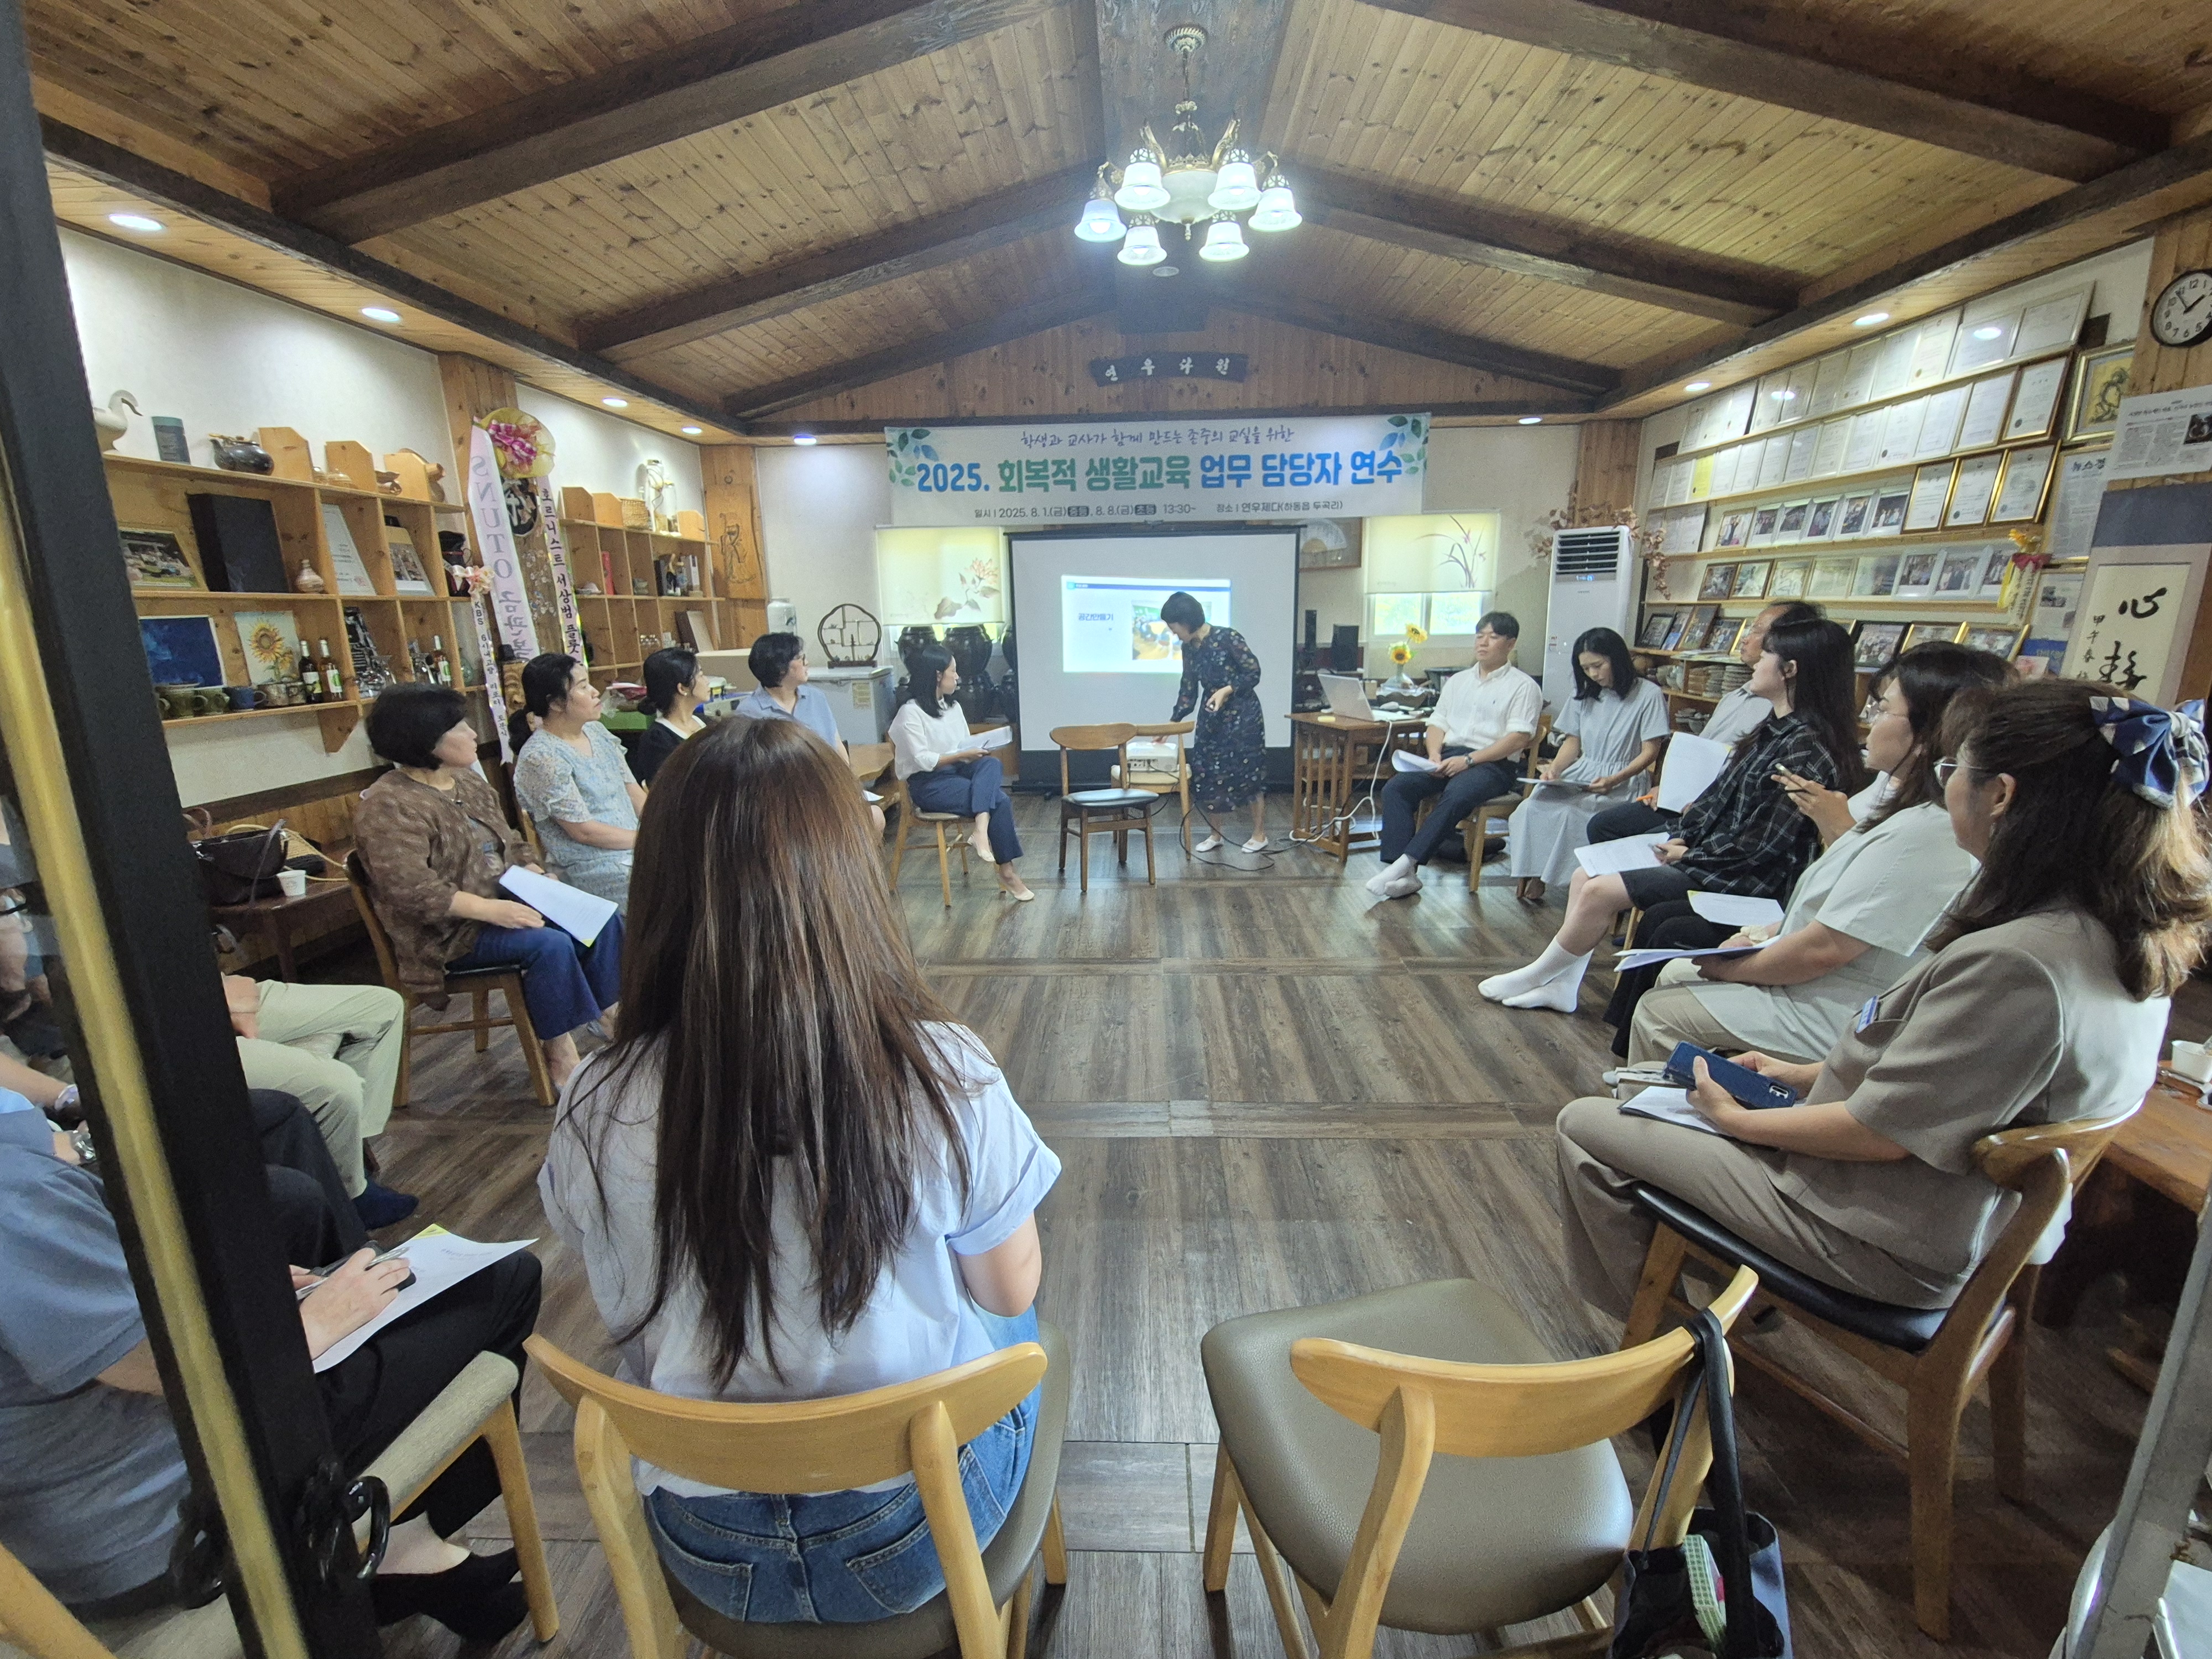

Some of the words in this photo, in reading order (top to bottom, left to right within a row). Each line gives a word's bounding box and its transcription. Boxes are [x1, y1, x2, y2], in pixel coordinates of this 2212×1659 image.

[1021, 431, 1063, 448] 학생과
[1068, 432, 1107, 446] 교사가
[1111, 428, 1142, 446] 함께
[1149, 429, 1182, 446] 만드는
[1188, 427, 1223, 446] 존중의
[1229, 425, 1261, 444] 교실을
[1266, 424, 1295, 442] 위한
[916, 462, 990, 492] 2025.
[998, 458, 1077, 493] 회복적
[1085, 455, 1192, 492] 생활교육
[1200, 453, 1252, 489] 업무
[1261, 450, 1343, 487] 담당자
[1350, 449, 1403, 485] 연수
[974, 509, 991, 518] 일시
[999, 508, 1028, 518] 2025.
[1217, 503, 1233, 513] 장소
[556, 573, 573, 619] 서상범
[474, 601, 484, 625] KBS
